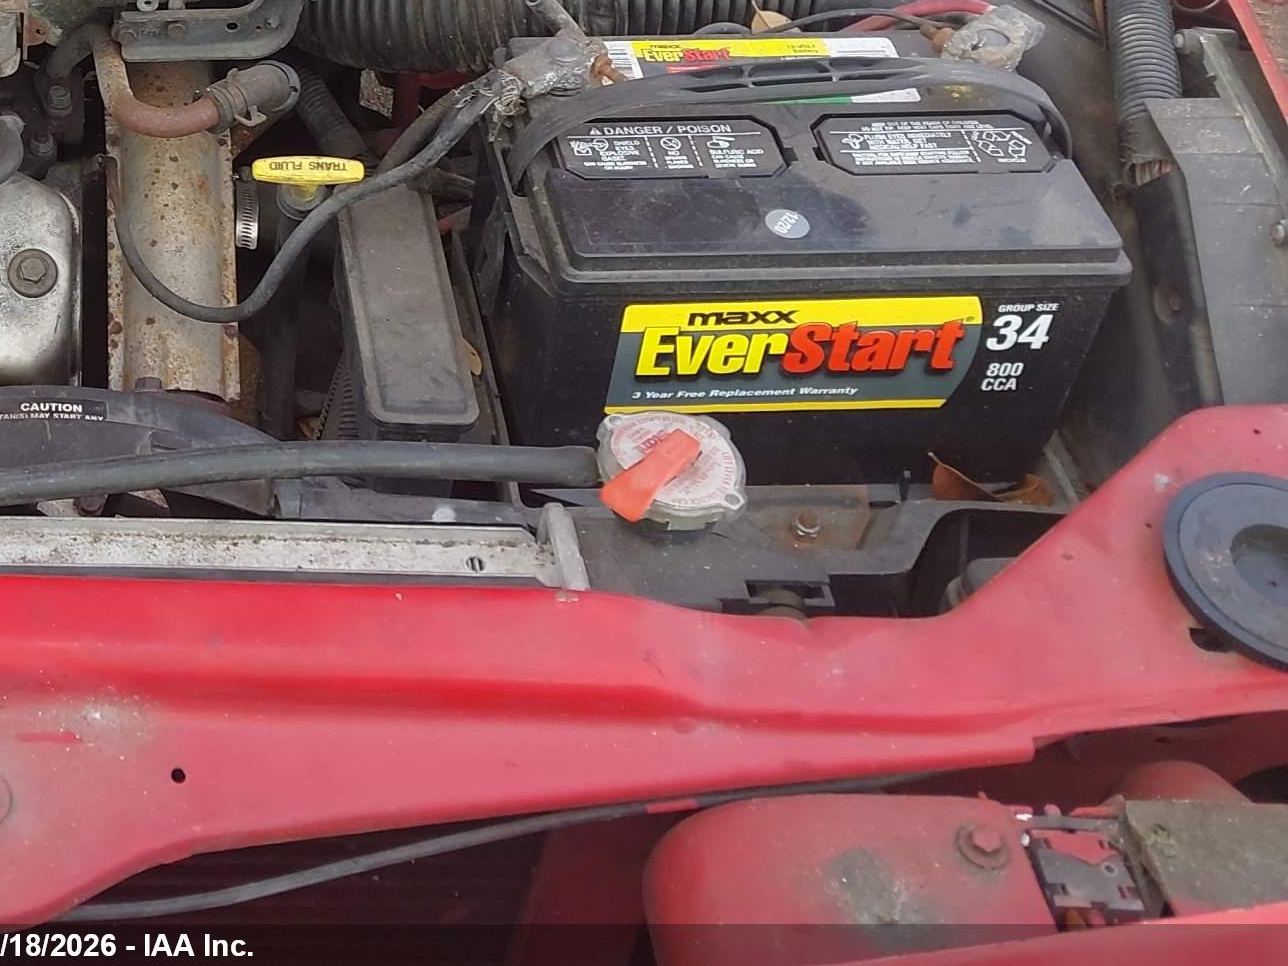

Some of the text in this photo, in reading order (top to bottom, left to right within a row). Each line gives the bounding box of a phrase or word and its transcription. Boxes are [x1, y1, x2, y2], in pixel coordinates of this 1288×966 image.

[642, 47, 732, 62] EverStart
[603, 125, 663, 135] DANGER
[677, 124, 732, 133] POISON
[269, 161, 347, 171] TRANS FLUID
[998, 302, 1060, 313] GROUP SIZE
[687, 309, 799, 327] maxx
[986, 314, 1054, 351] 34
[634, 318, 966, 377] EverStart
[986, 362, 1025, 377] 800
[981, 377, 1018, 391] CCA
[632, 386, 859, 399] 3 Year Free Replacement Warranty
[20, 402, 83, 413] CAUTION
